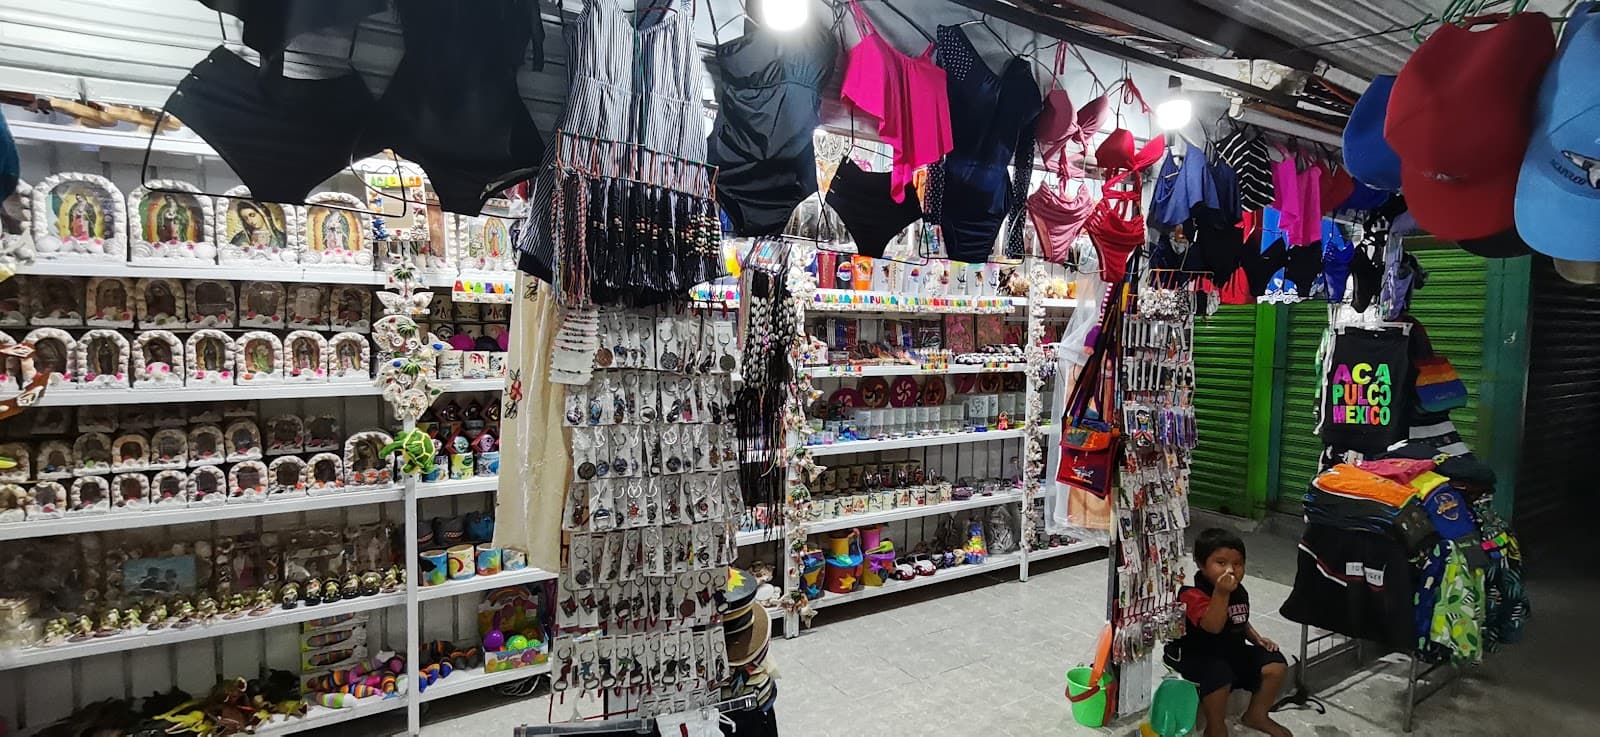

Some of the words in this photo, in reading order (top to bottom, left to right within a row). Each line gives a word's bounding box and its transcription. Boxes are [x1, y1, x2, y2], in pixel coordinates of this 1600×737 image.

[1332, 363, 1392, 385] ACA
[1332, 384, 1392, 406] PULCO
[1332, 406, 1391, 425] MEXICO
